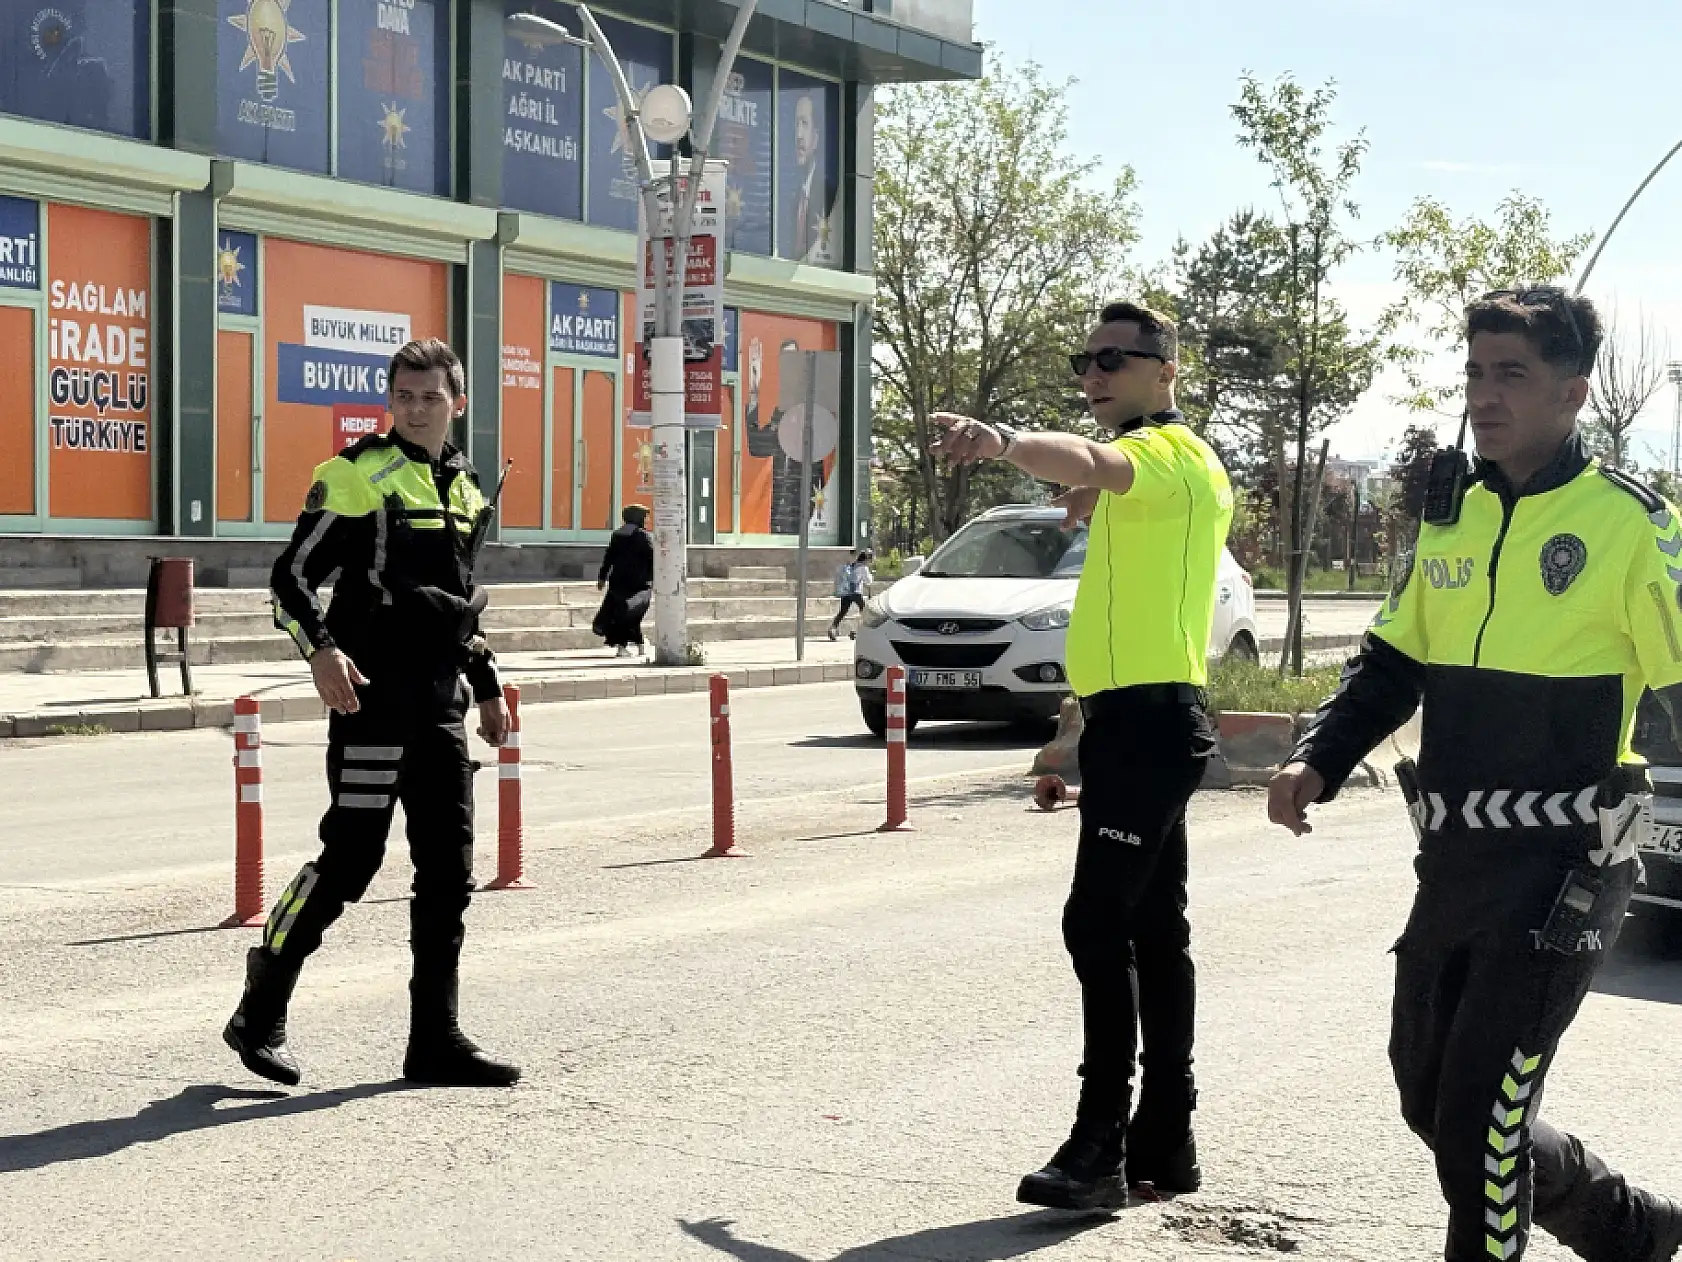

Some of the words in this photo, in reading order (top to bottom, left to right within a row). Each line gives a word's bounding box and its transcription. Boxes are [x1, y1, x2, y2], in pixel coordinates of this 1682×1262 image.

[502, 58, 522, 81] AK
[525, 63, 566, 93] PARTİ
[508, 91, 542, 122] AĞRI
[546, 97, 559, 125] İL
[502, 126, 577, 163] AŞKANLIĞI
[0, 233, 36, 266] RTİ
[0, 266, 36, 284] ANLIĞI
[50, 279, 147, 319] SAĞLAM
[50, 319, 147, 368] İRADE
[310, 317, 356, 341] BÜYÜK
[359, 325, 405, 346] MİLLET
[551, 313, 573, 336] AK
[575, 314, 616, 341] PARTİ
[50, 366, 148, 416] GÜÇLÜ
[303, 360, 371, 393] BÜYÜK
[374, 367, 388, 395] G
[50, 415, 148, 453] TÜRKİYE
[340, 416, 378, 433] HEDEF
[936, 672, 956, 685] FMG
[1098, 827, 1142, 847] POLİS
